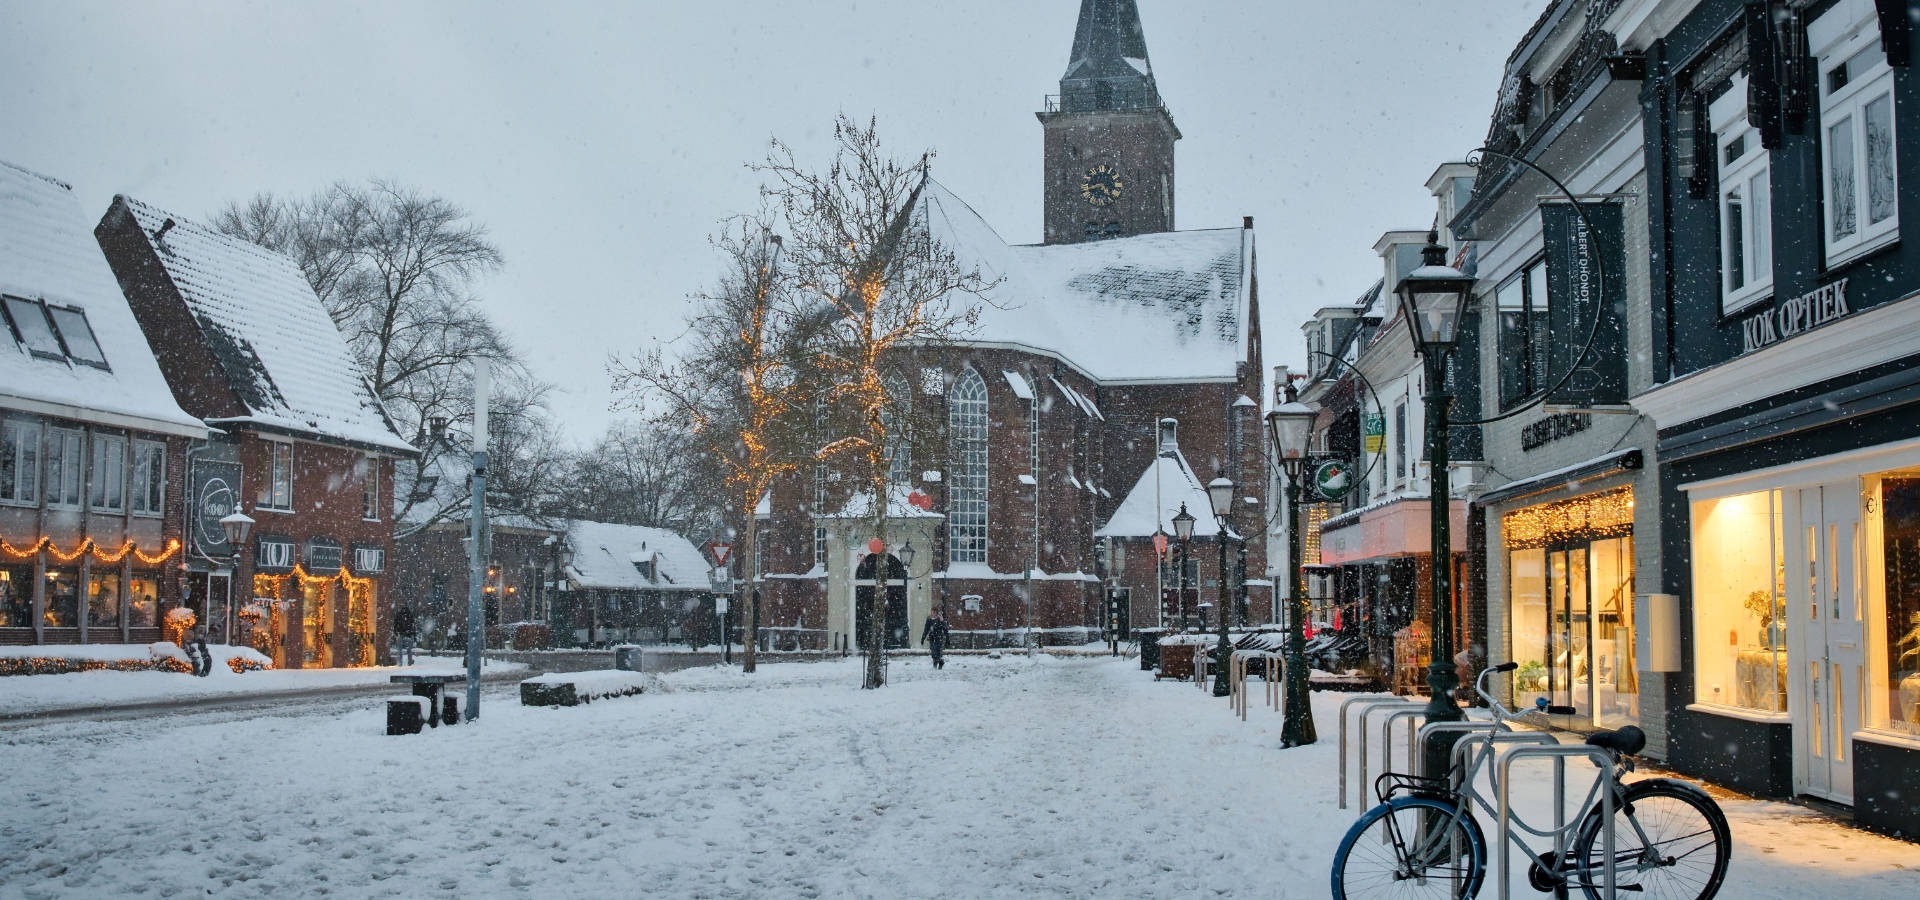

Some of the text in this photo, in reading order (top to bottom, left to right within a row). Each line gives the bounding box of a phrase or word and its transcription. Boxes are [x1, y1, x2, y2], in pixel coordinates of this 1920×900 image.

[1579, 258, 1590, 304] DHONDT
[1742, 277, 1849, 352] KOK OPTIEK
